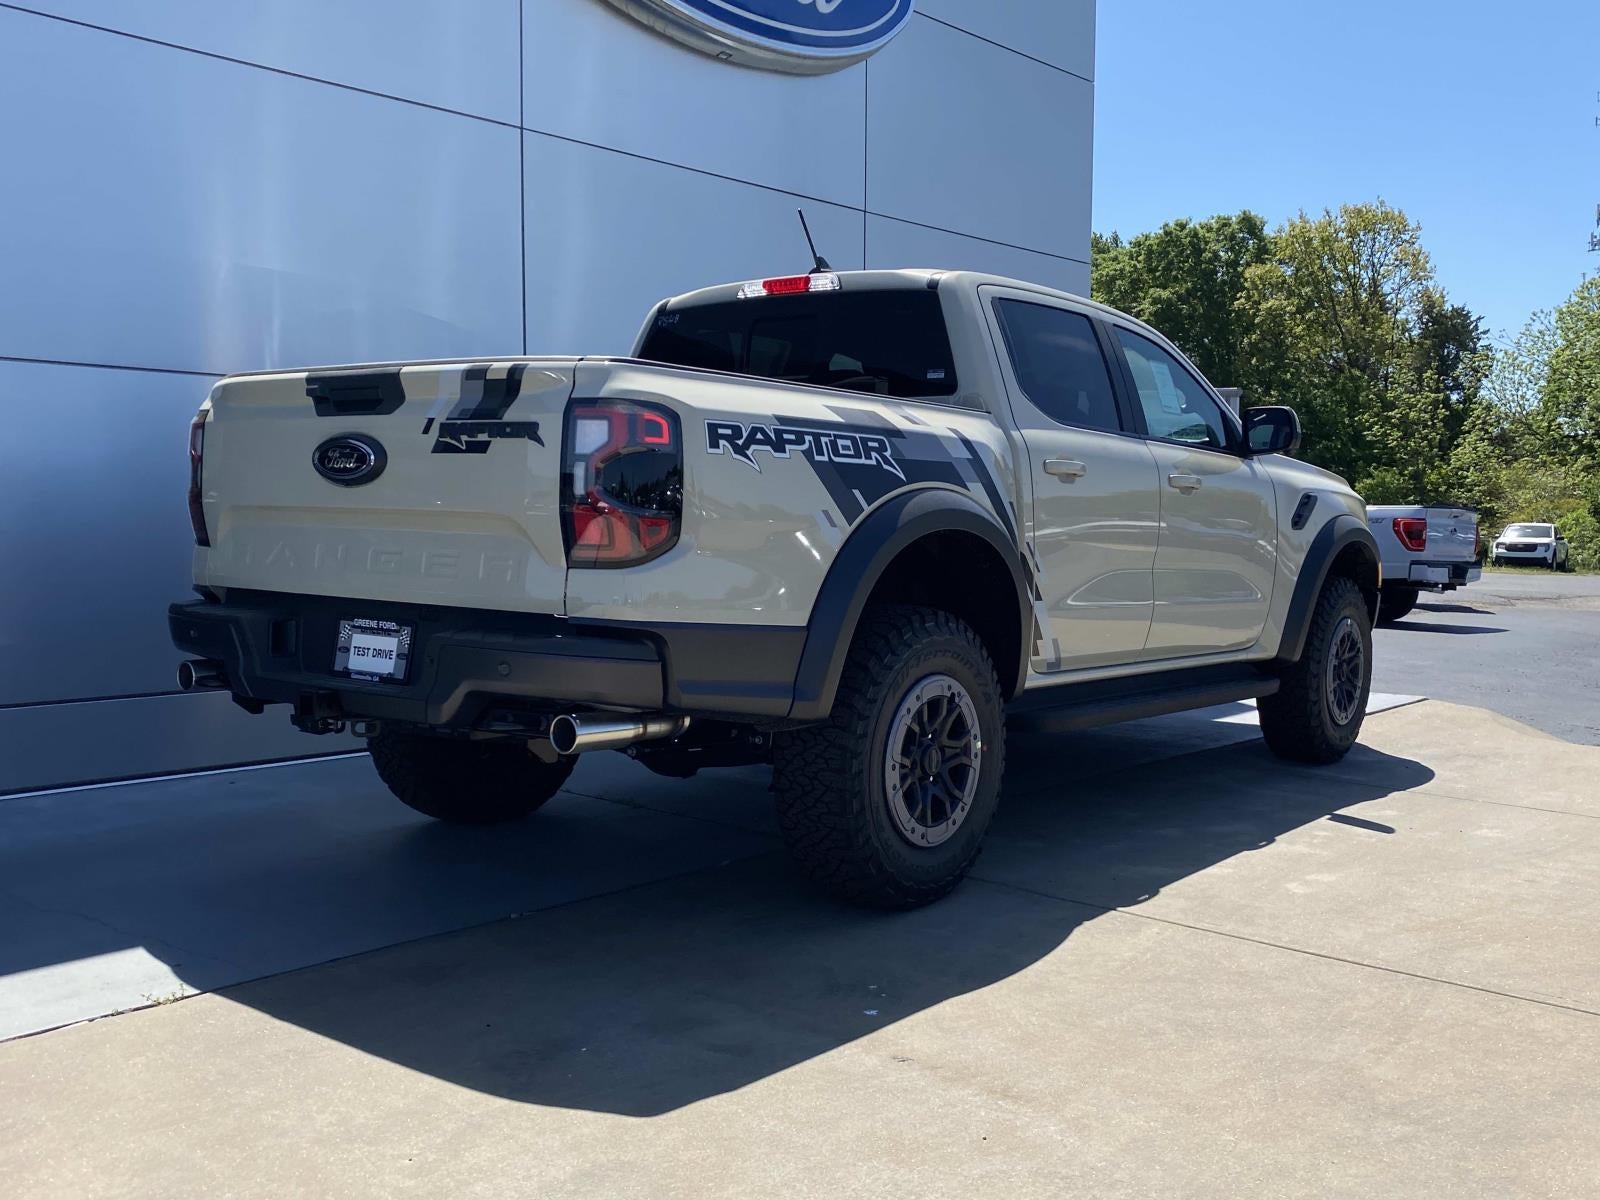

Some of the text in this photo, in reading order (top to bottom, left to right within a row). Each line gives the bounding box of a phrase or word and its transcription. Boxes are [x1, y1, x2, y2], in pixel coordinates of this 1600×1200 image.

[324, 447, 361, 469] Ford
[703, 418, 906, 481] RAPTOR
[353, 619, 397, 630] GREENE FORD
[353, 645, 371, 657] TEST
[372, 647, 394, 660] DRIVE
